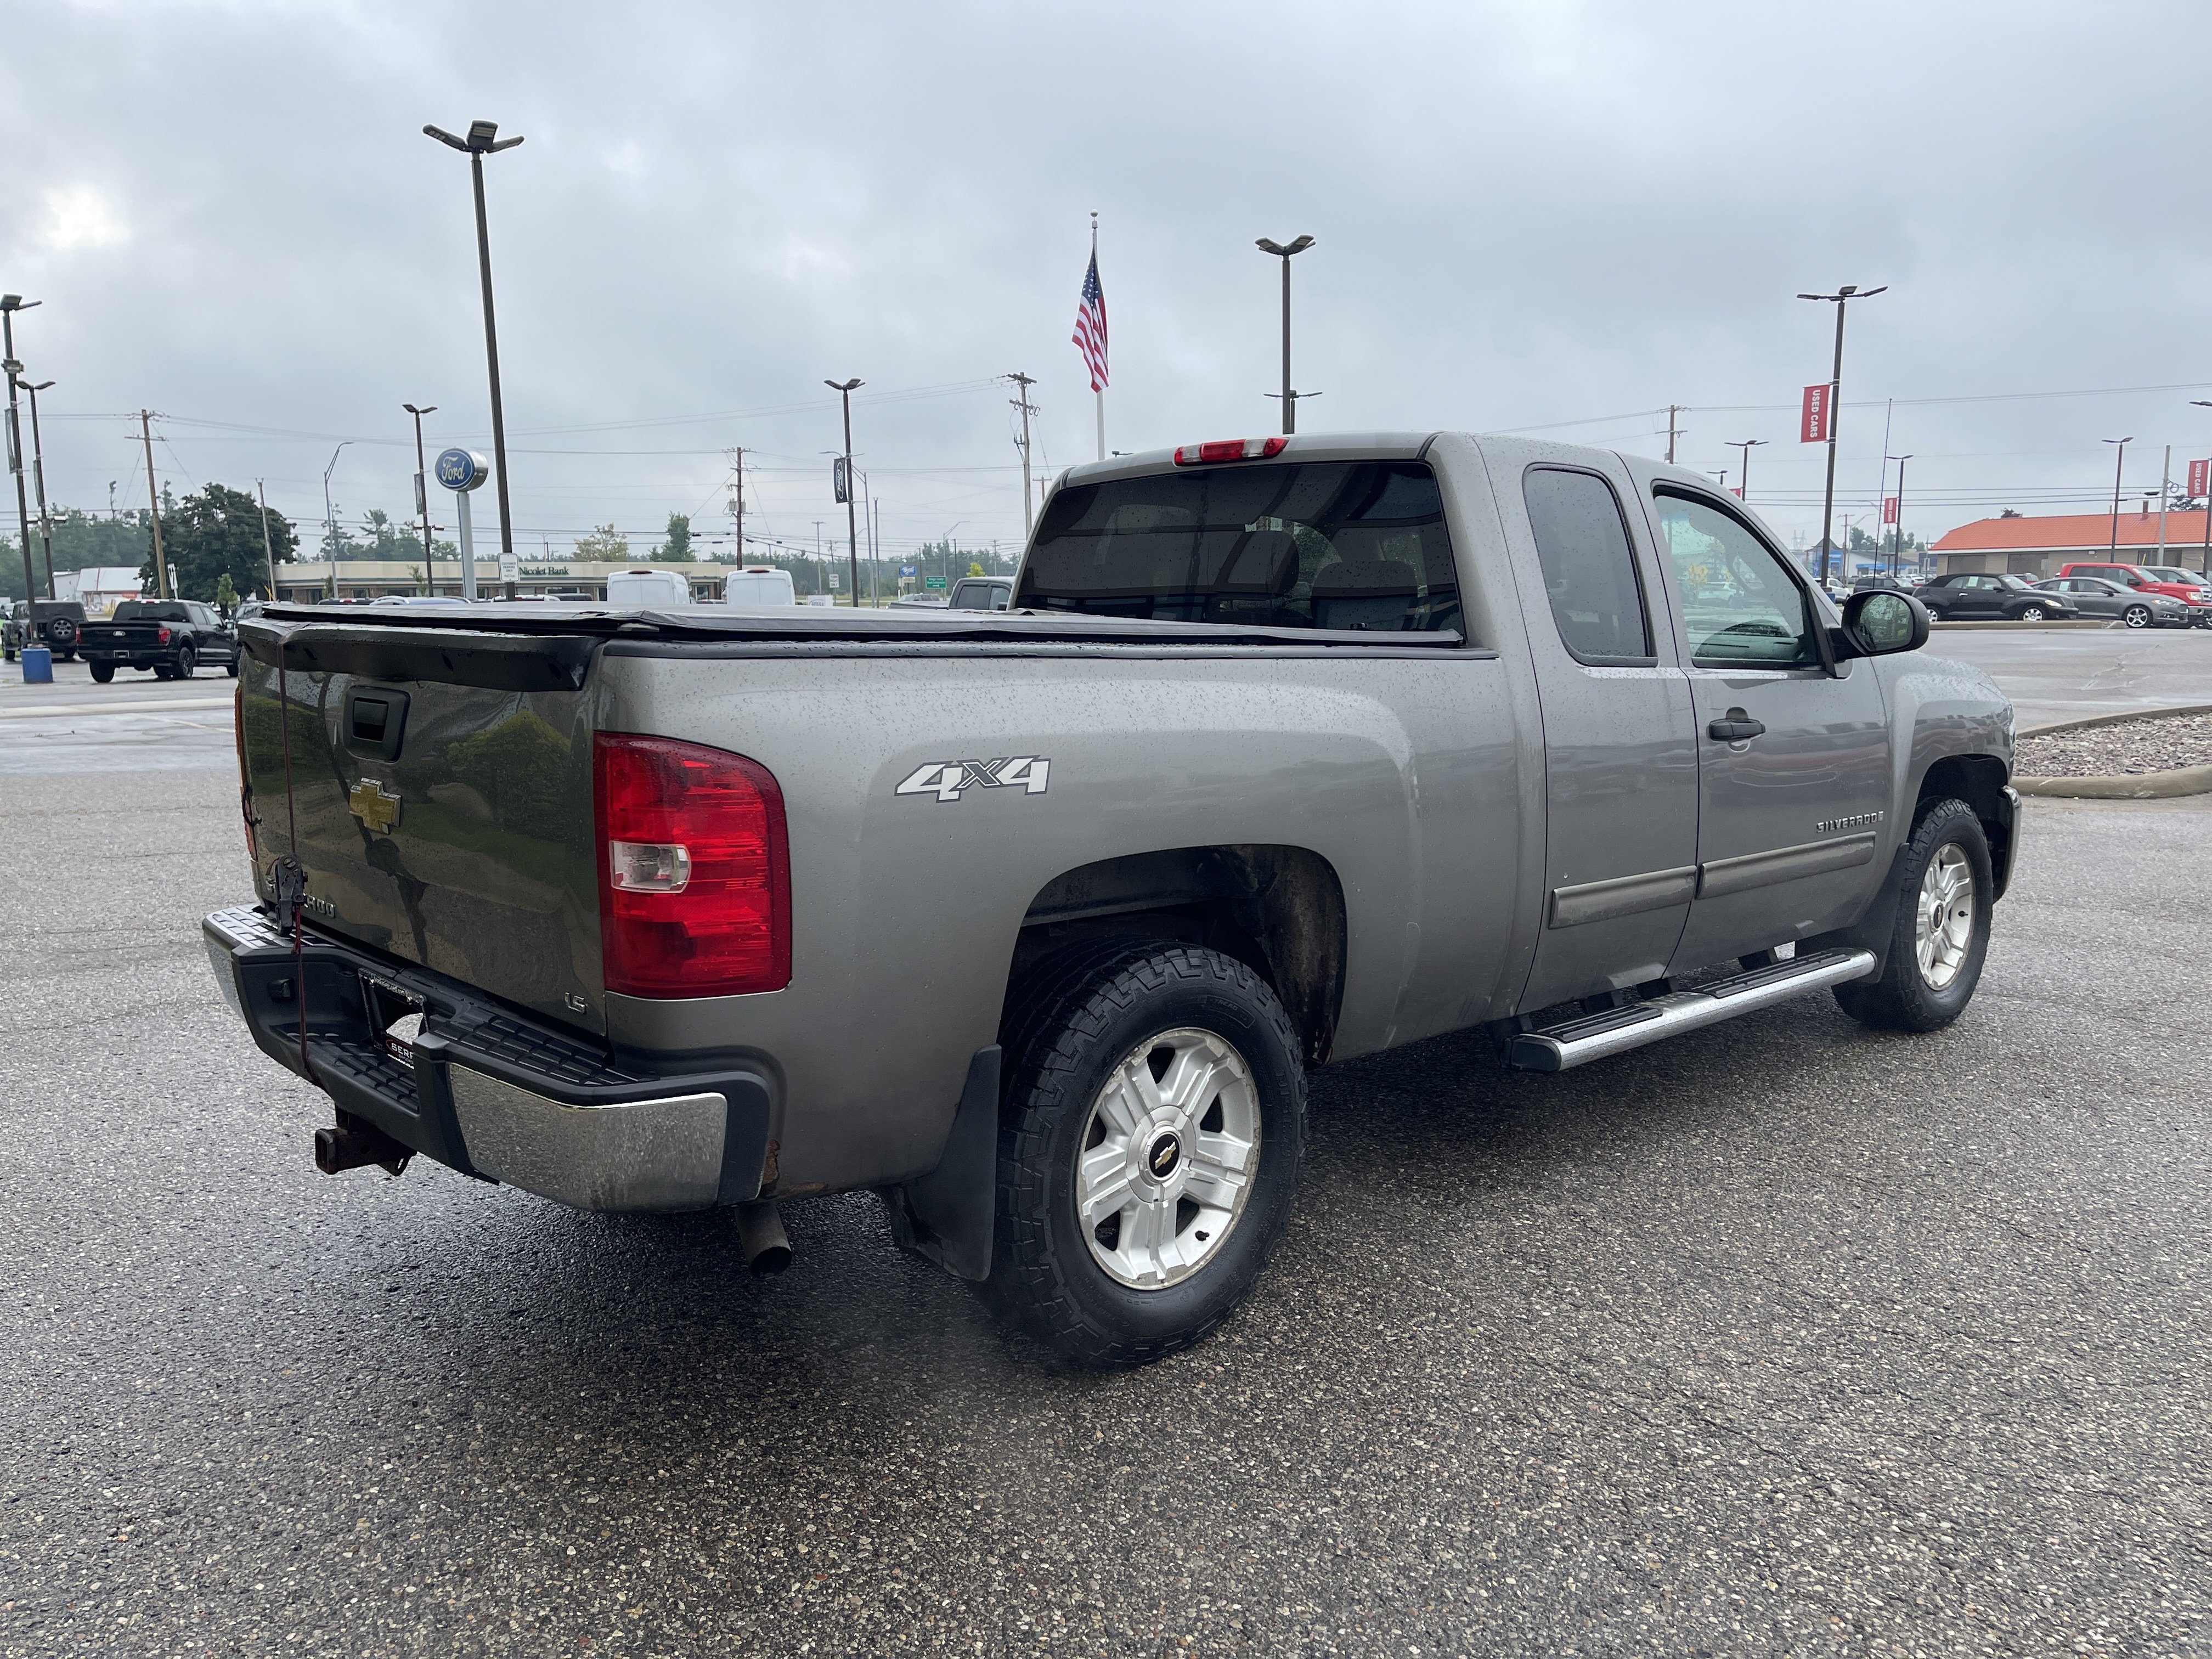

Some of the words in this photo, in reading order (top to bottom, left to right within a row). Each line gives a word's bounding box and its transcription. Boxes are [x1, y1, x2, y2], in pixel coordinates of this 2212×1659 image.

[1811, 390, 1821, 413] USED
[1810, 414, 1819, 438] CARS
[441, 456, 465, 481] Ford
[519, 566, 545, 575] Nicolet
[548, 566, 569, 575] Bank
[1816, 812, 1877, 833] SILVERADO
[565, 992, 585, 1013] LS
